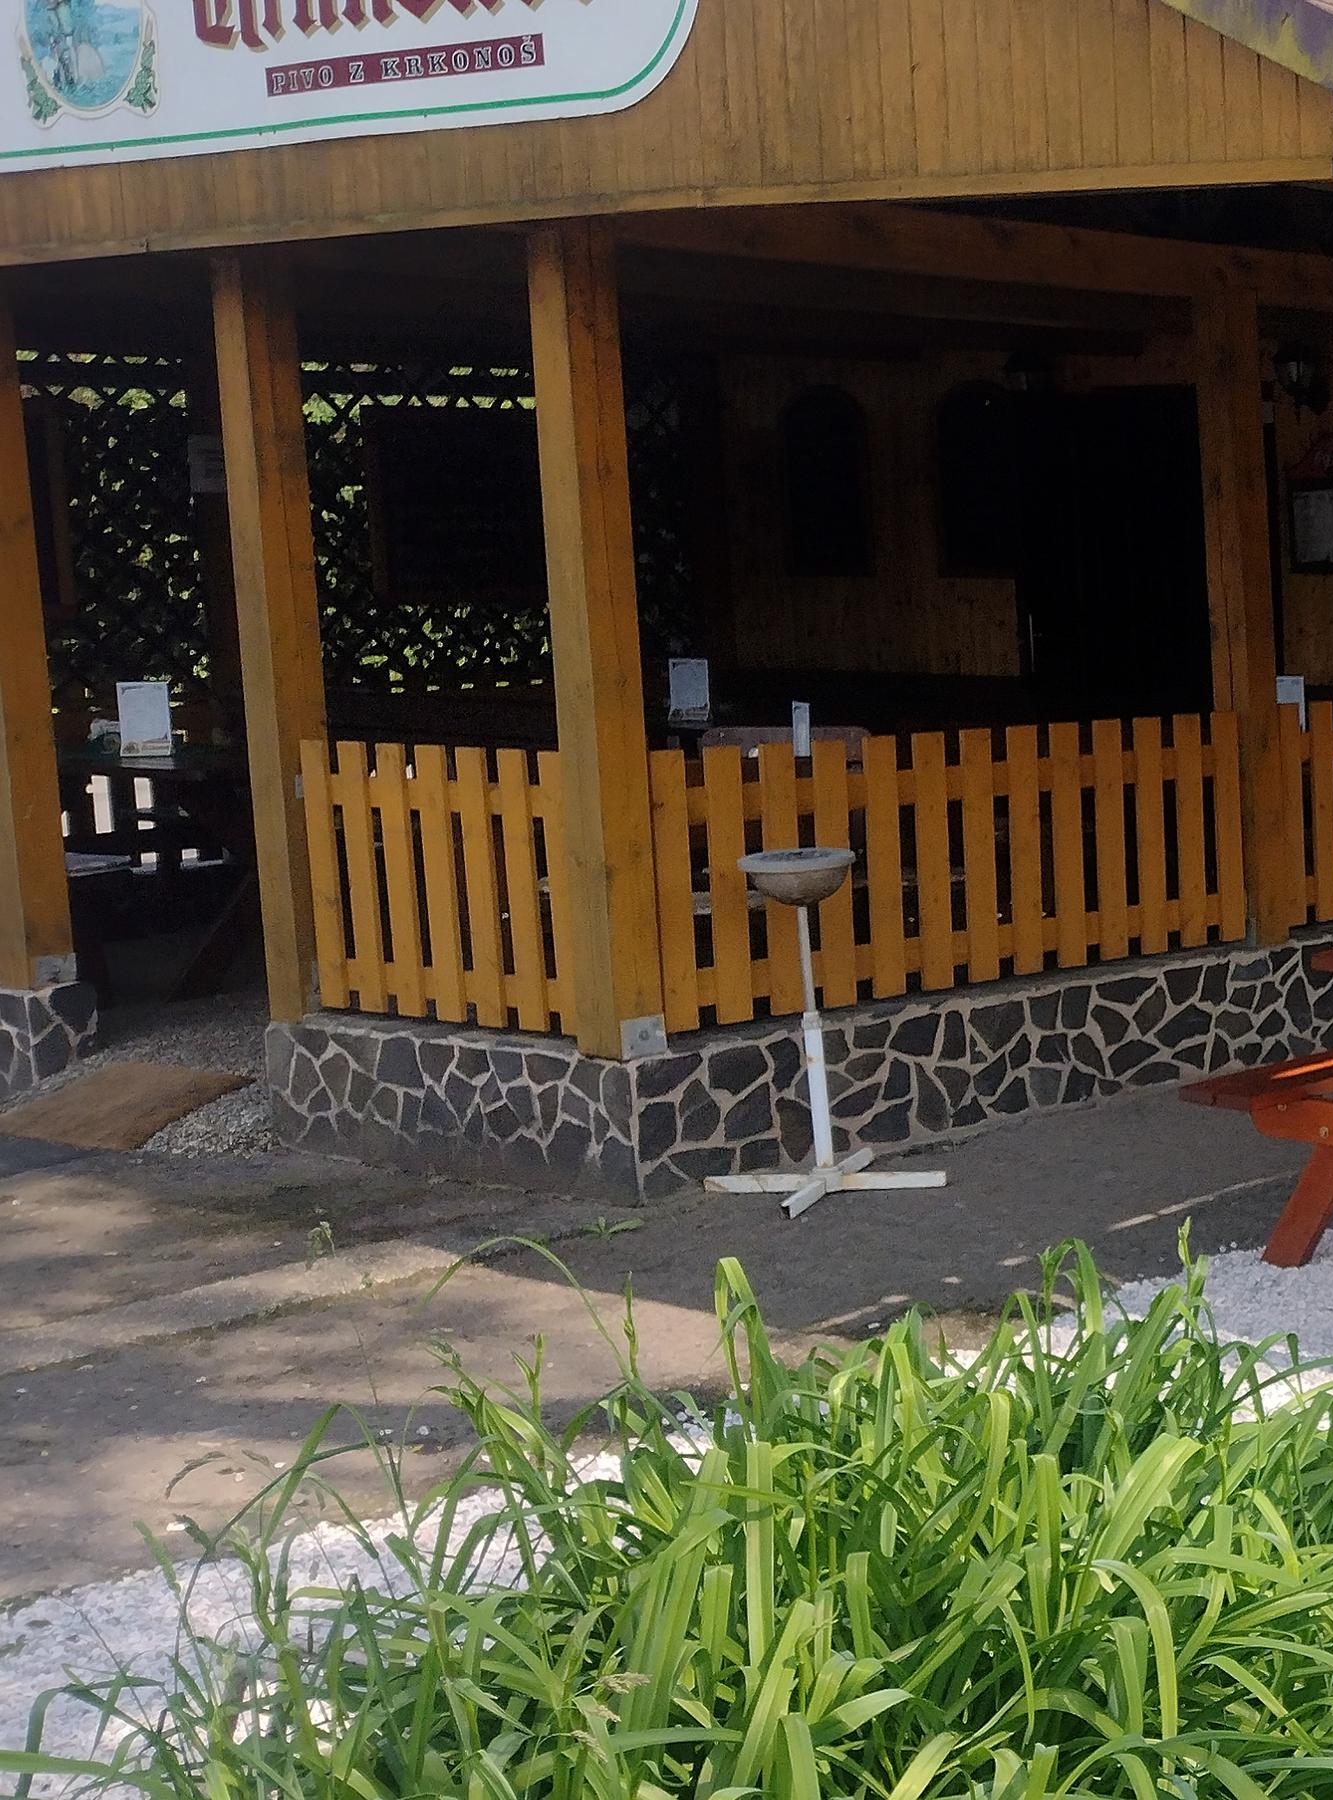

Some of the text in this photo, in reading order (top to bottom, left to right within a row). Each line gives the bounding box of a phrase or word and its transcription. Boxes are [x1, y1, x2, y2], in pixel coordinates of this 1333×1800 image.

[272, 34, 536, 94] PIVO Z KRKONOŠ
